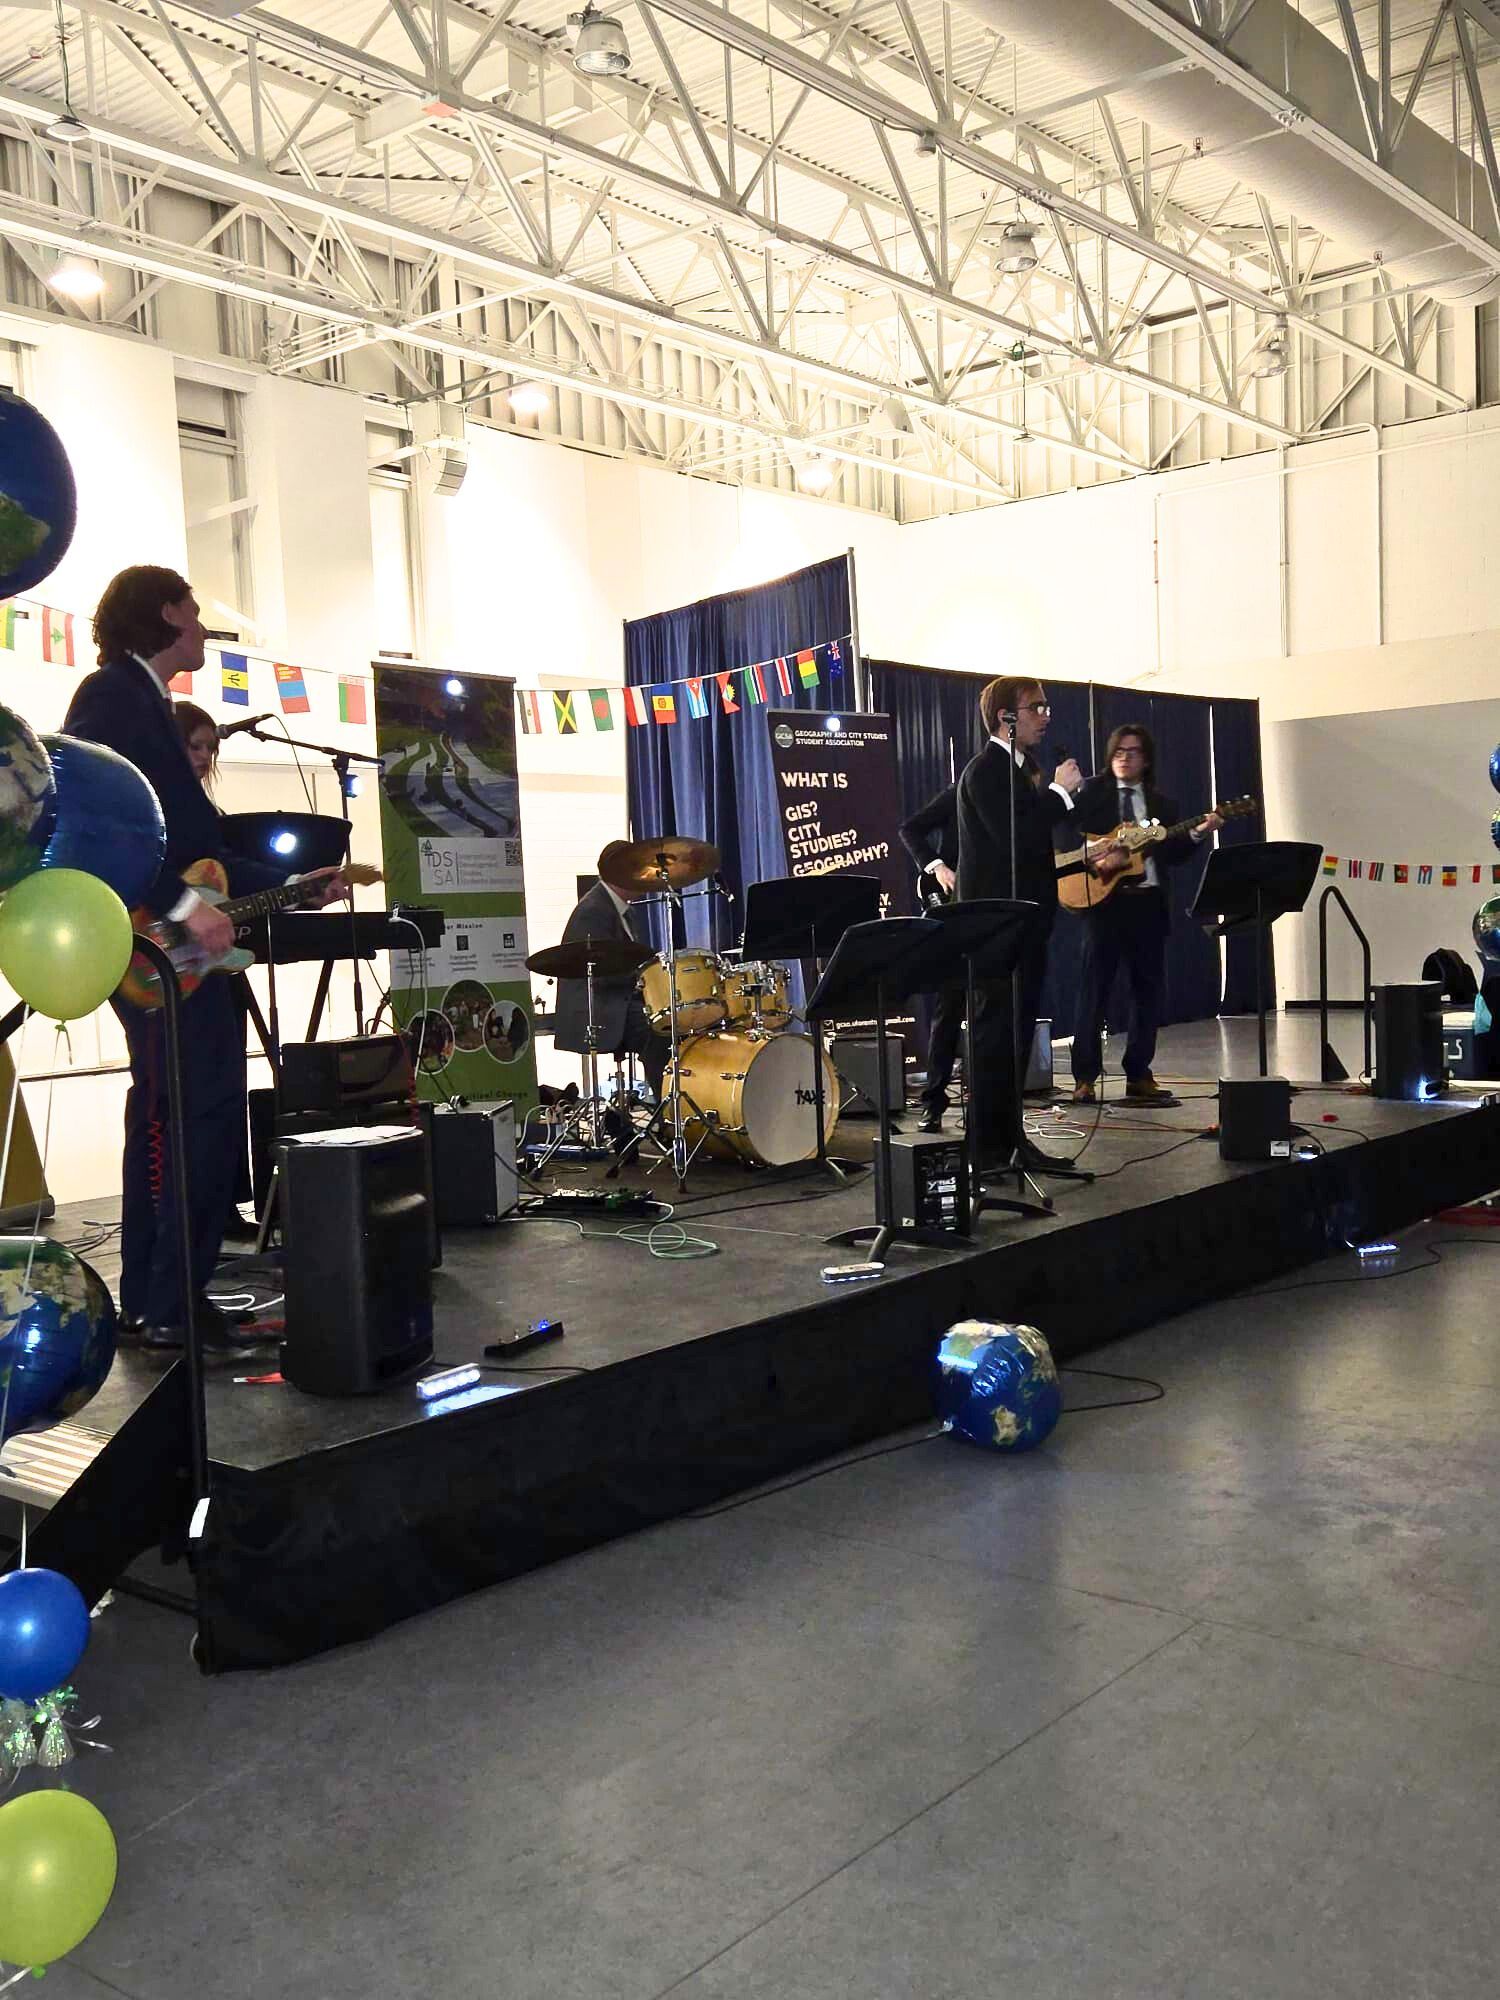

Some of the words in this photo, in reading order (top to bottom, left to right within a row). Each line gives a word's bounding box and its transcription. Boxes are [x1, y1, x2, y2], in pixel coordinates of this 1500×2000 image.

[795, 729, 832, 738] GEOGRAPHY
[863, 732, 888, 740] STUDIES
[781, 772, 828, 788] WHAT
[833, 772, 848, 788] IS
[785, 801, 818, 821] GIS?
[788, 821, 821, 842] CITY
[790, 829, 857, 859] STUDIES?
[792, 842, 889, 877] GEOGRAPHY?
